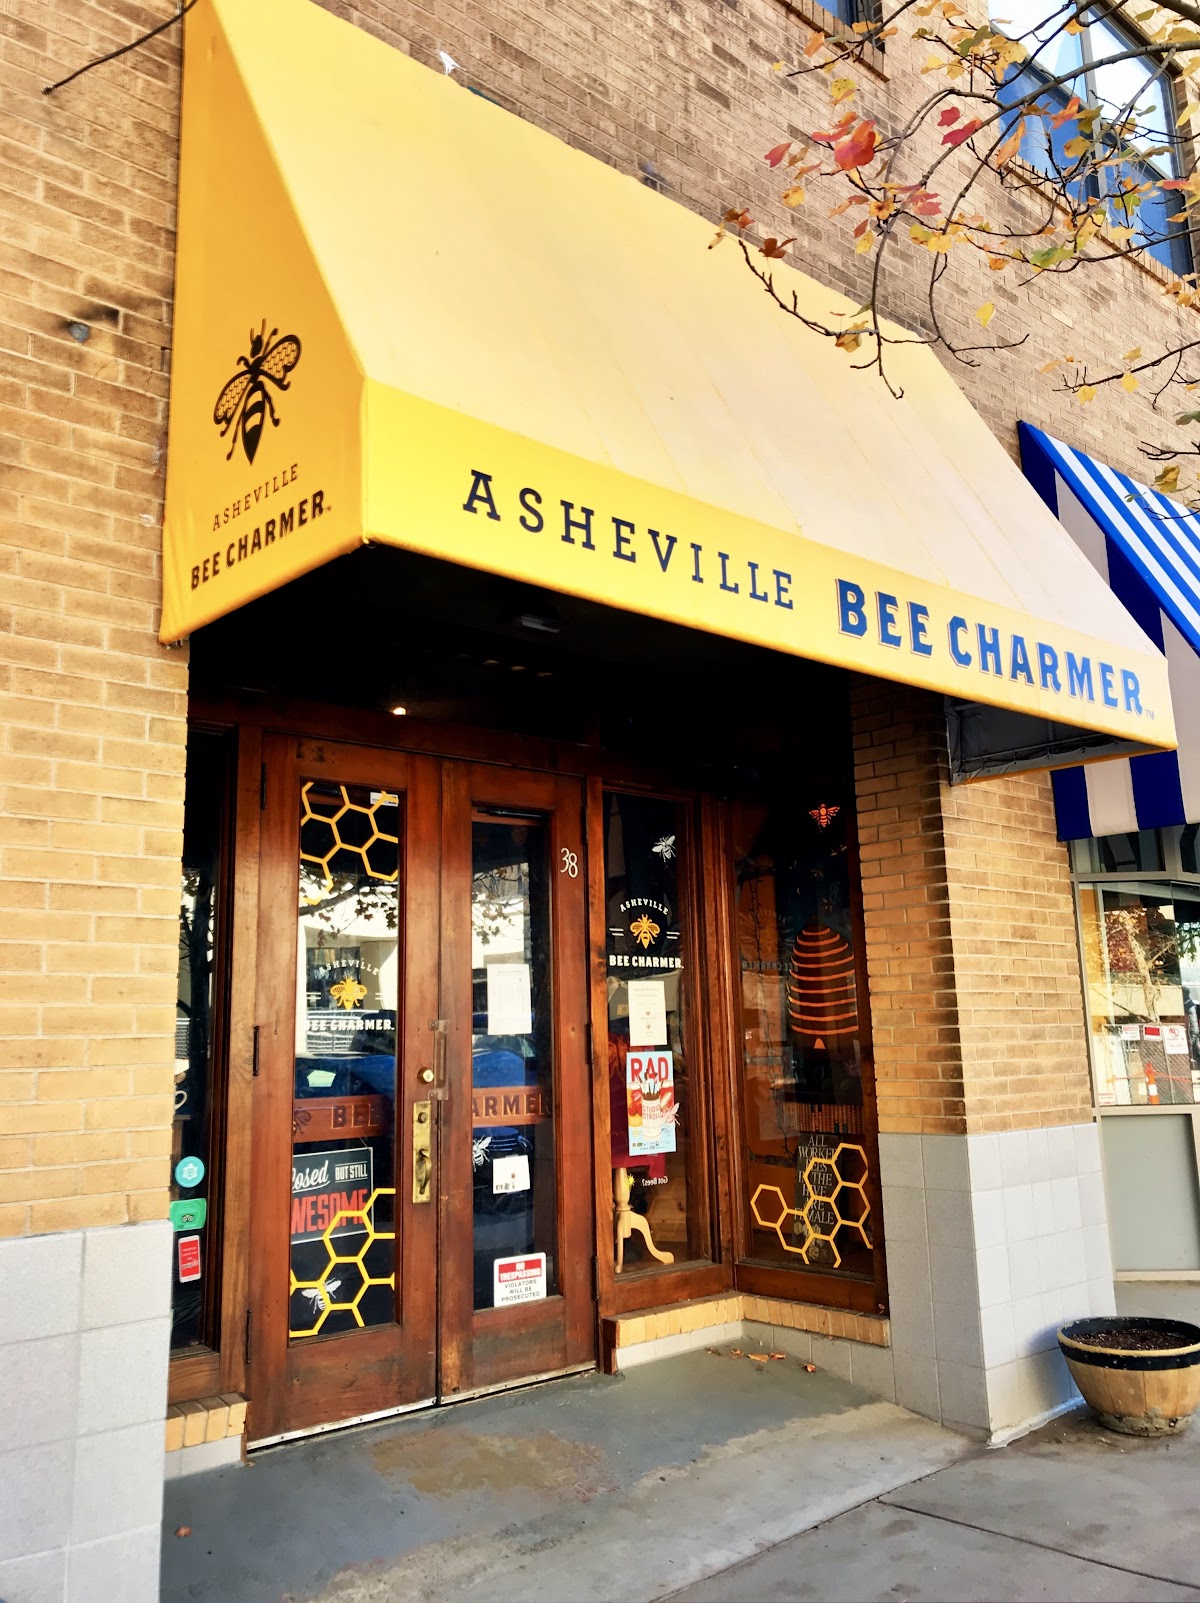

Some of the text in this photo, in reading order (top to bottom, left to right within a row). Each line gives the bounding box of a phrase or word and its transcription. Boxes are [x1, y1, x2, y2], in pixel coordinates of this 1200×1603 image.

[212, 463, 299, 532] ASHEVILLE
[190, 551, 221, 591] BEE
[225, 489, 325, 568] CHARMER
[462, 469, 794, 611] ASHEVILLE
[834, 577, 933, 658] BEE
[947, 615, 1143, 716] CHARMER
[559, 847, 579, 878] 38
[619, 897, 670, 916] ASHEVILLE
[319, 959, 380, 976] ASHEVILLE
[608, 954, 631, 967] BEE
[630, 1057, 669, 1082] RAD
[330, 1103, 380, 1130] BEE
[807, 1134, 828, 1147] ALL
[335, 1165, 349, 1181] BUT
[349, 1163, 368, 1178] STILL
[811, 1172, 833, 1187] THE
[290, 1189, 369, 1235] WESOME
[500, 1267, 542, 1282] TRESPASSING
[504, 1279, 537, 1289] VIOLATORS
[509, 1287, 523, 1295] WILL
[501, 1291, 541, 1302] PROSECUTED
